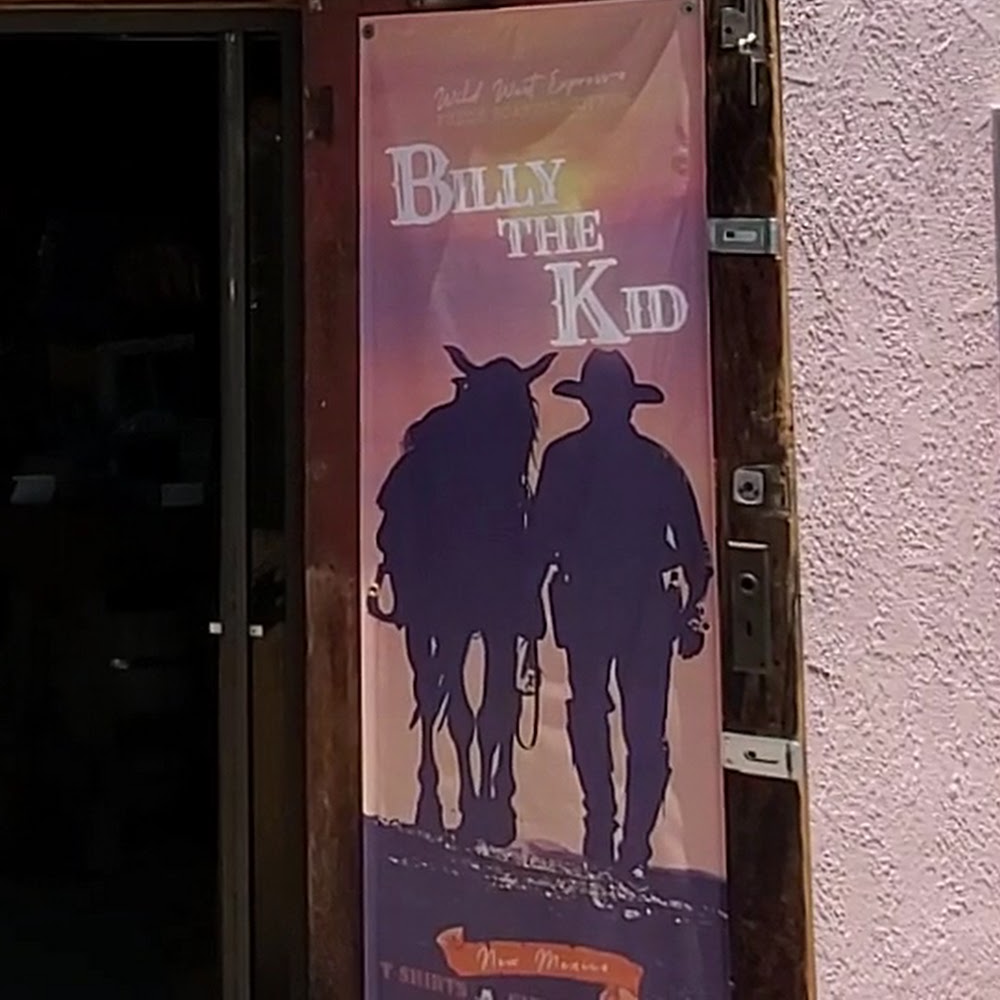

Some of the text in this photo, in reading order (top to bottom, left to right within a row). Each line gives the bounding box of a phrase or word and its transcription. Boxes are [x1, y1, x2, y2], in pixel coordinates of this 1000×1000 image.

[496, 209, 605, 258] THE
[475, 946, 609, 973] New Mexico
